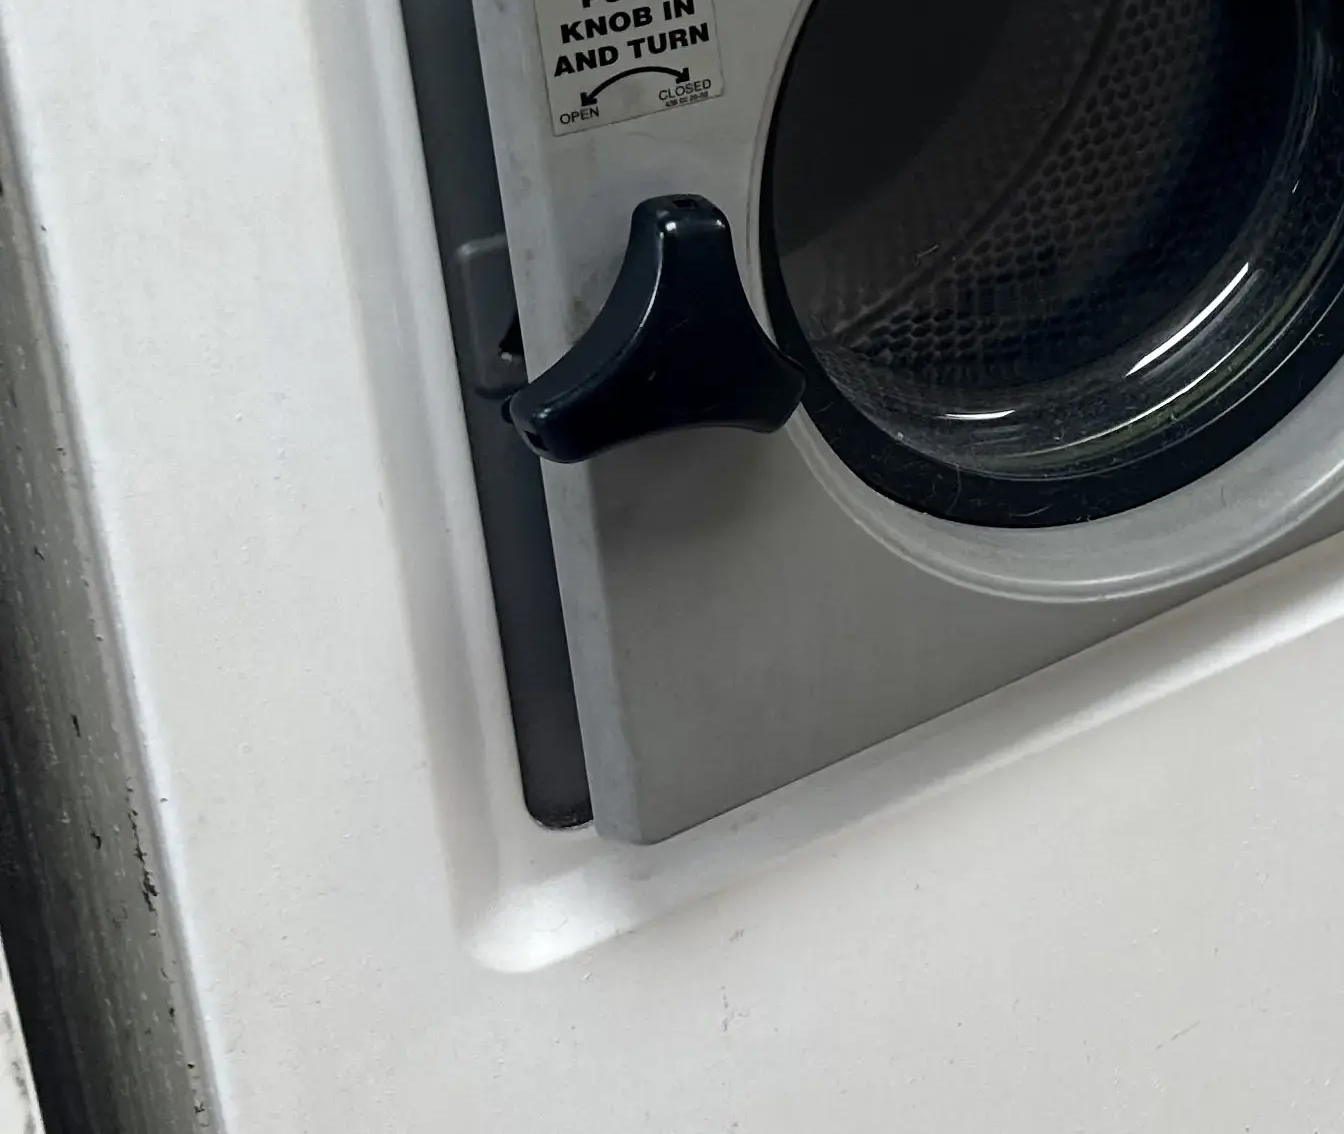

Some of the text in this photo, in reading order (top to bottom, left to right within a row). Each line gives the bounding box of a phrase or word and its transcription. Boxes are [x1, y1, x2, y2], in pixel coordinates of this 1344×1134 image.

[561, 6, 653, 44] KNOB
[554, 23, 709, 77] AND TURN
[659, 78, 711, 101] CLOSED
[560, 106, 599, 125] OPEN
